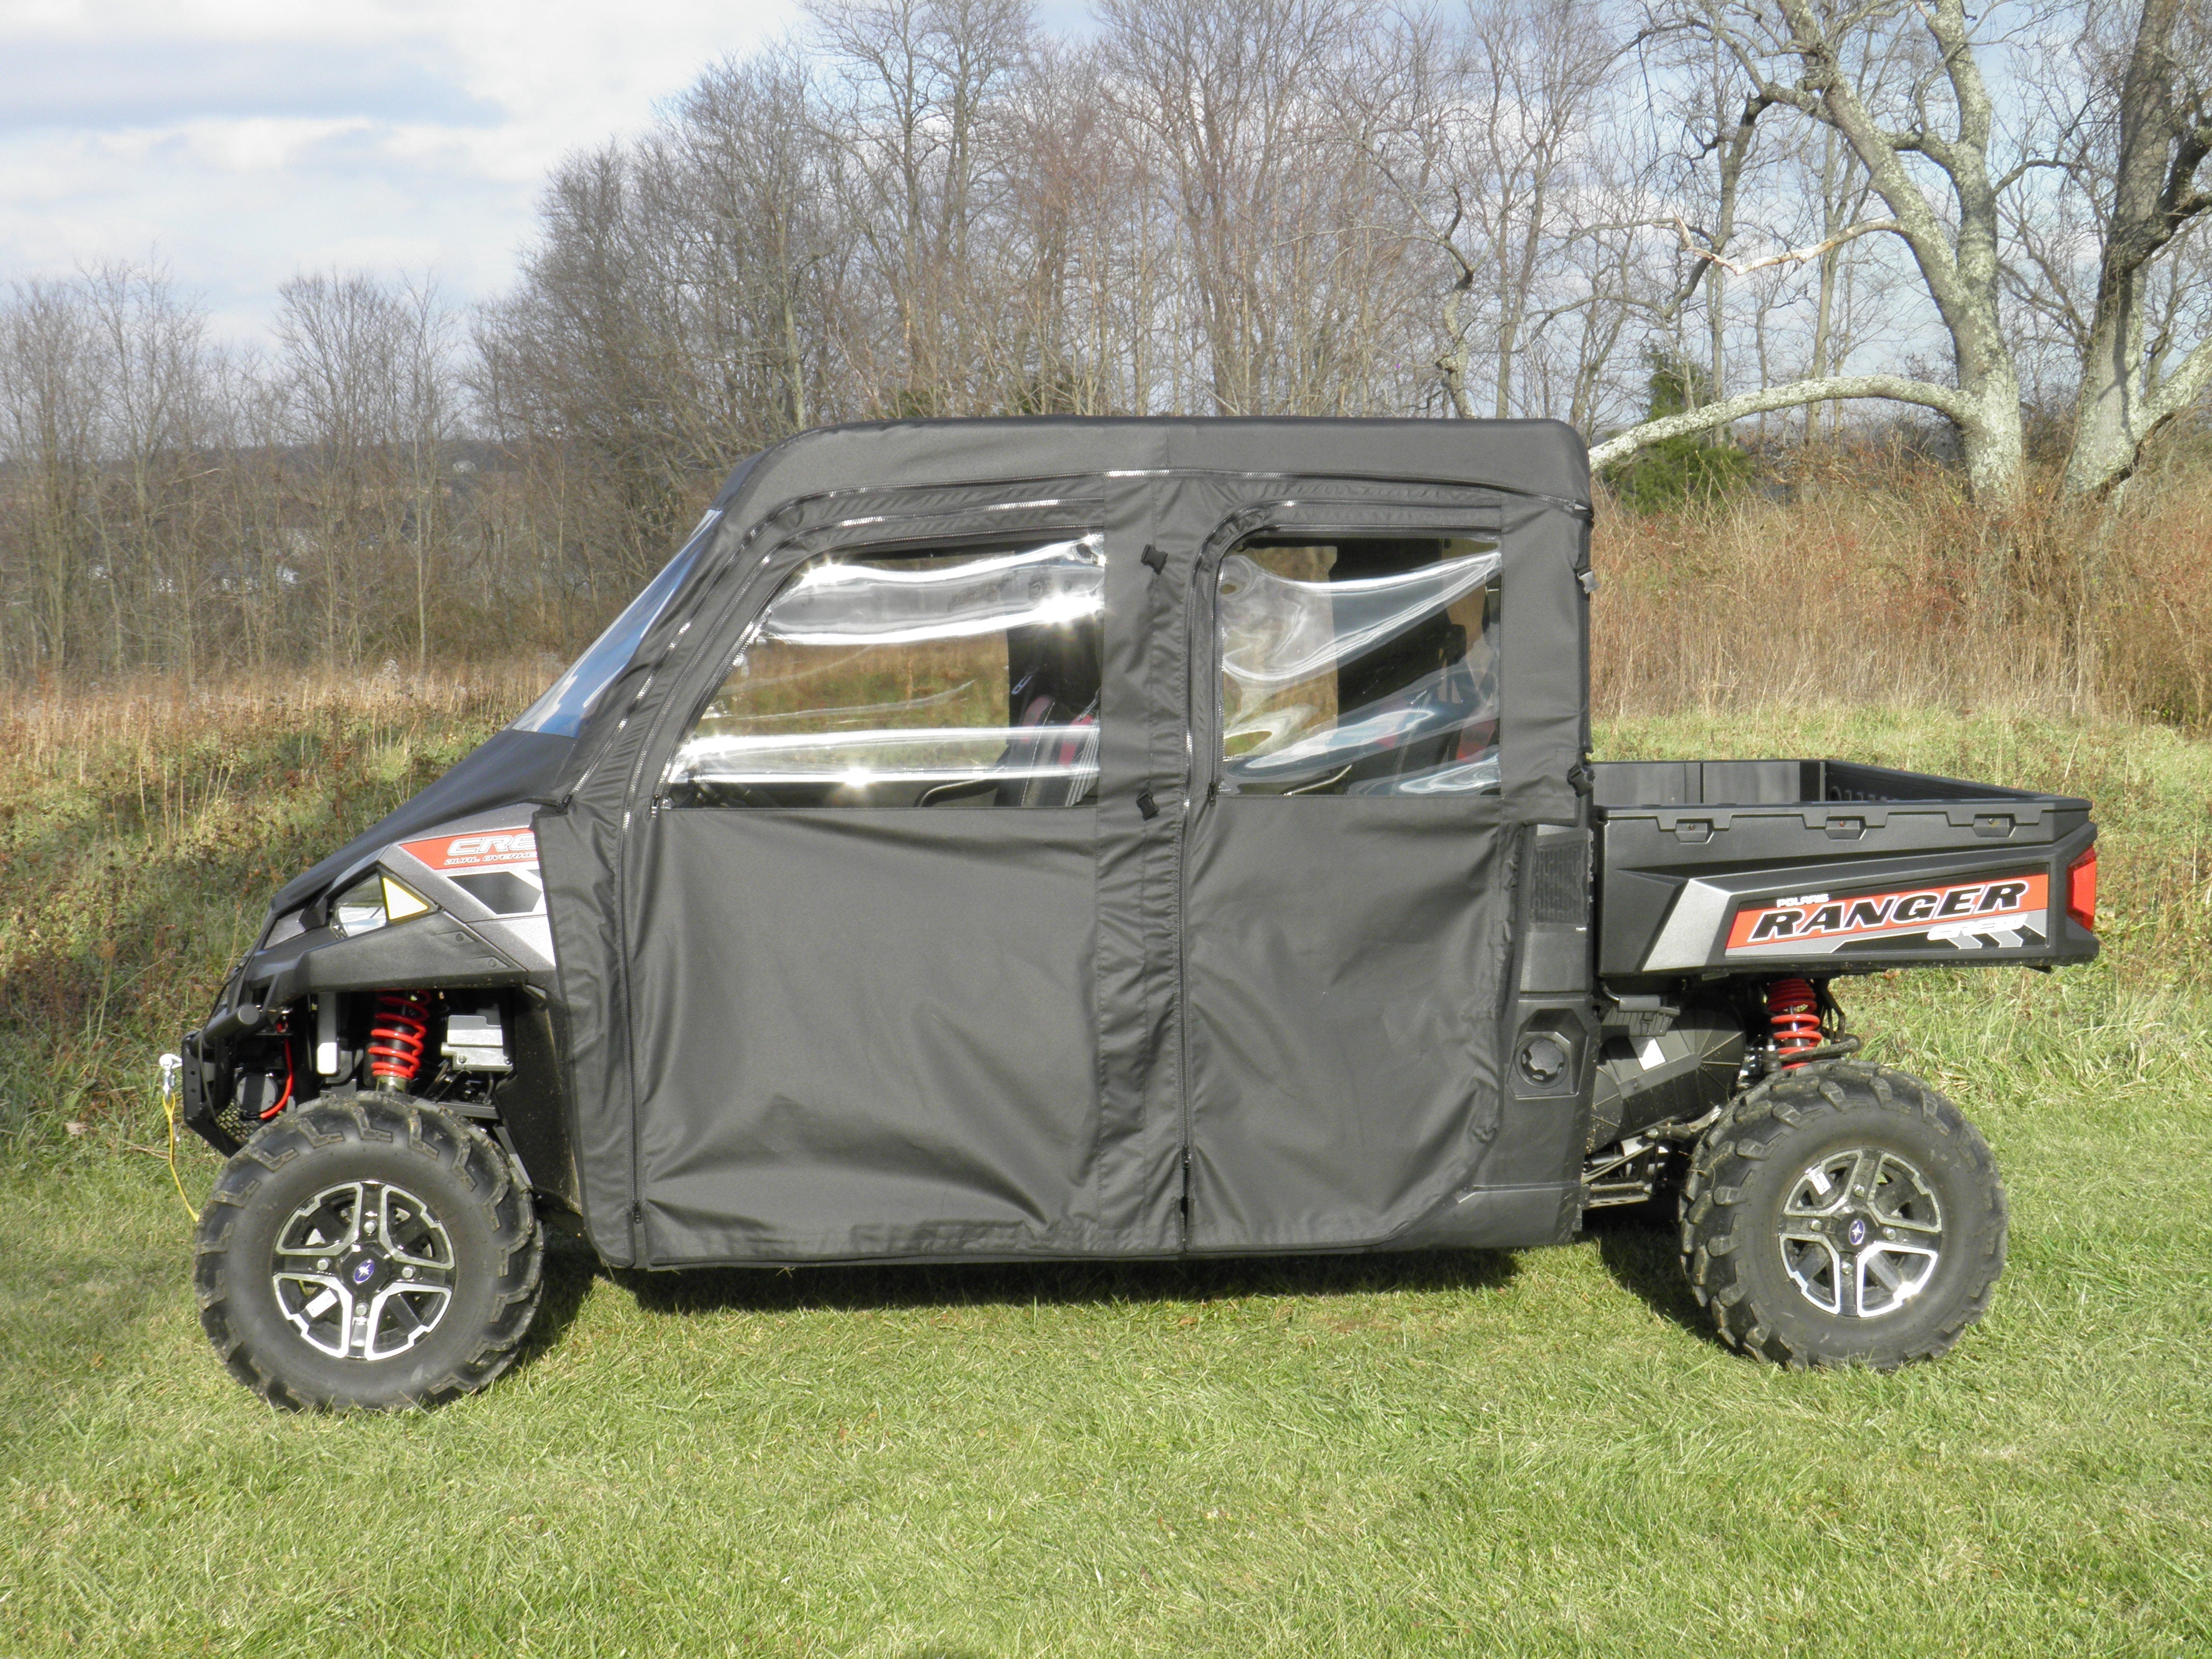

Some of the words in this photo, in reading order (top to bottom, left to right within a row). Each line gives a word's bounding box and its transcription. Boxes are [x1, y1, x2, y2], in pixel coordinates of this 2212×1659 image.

[447, 833, 536, 856] CRE
[444, 857, 480, 865] DUAL
[482, 851, 538, 861] OVERHE
[1777, 893, 1829, 908] POLARIS
[1747, 880, 2029, 942] RANGER
